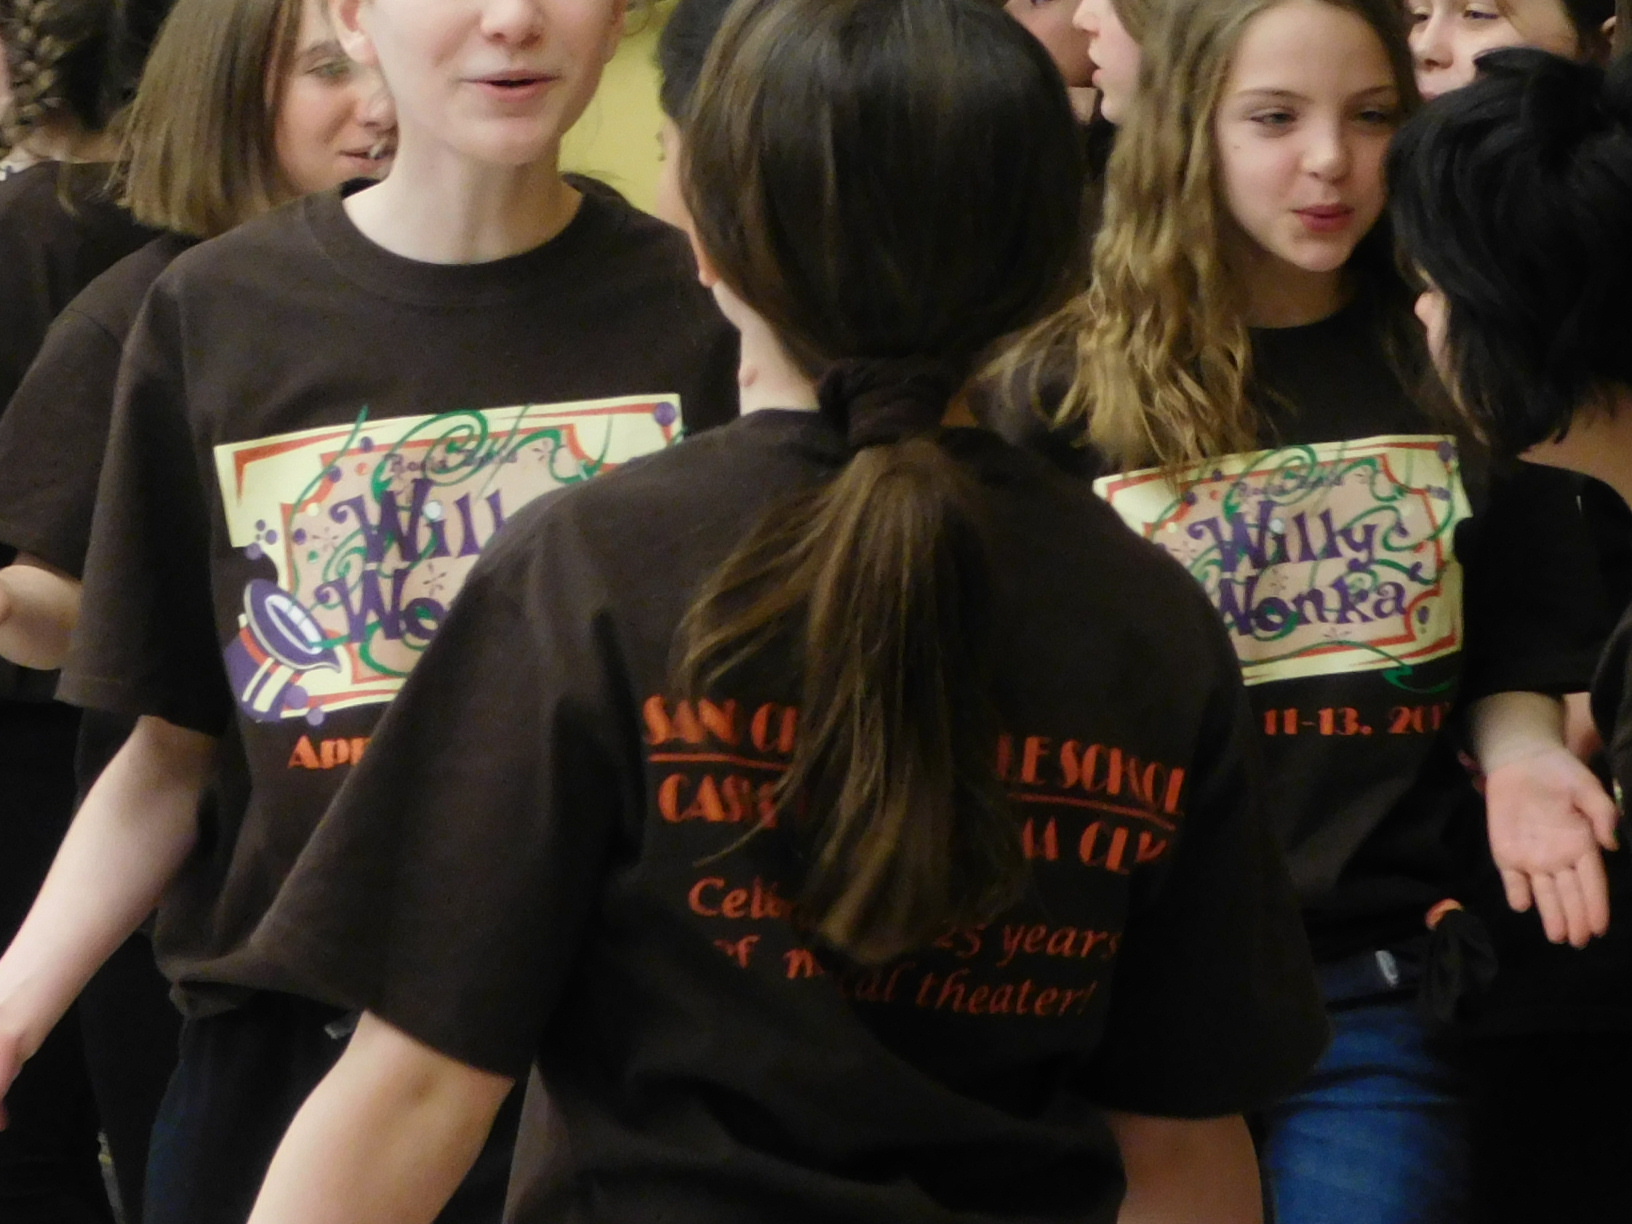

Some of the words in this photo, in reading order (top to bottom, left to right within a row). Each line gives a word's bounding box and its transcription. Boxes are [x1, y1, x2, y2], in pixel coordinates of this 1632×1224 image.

[330, 478, 506, 564] Will
[1188, 500, 1378, 575] Willy
[996, 924, 1124, 968] years
